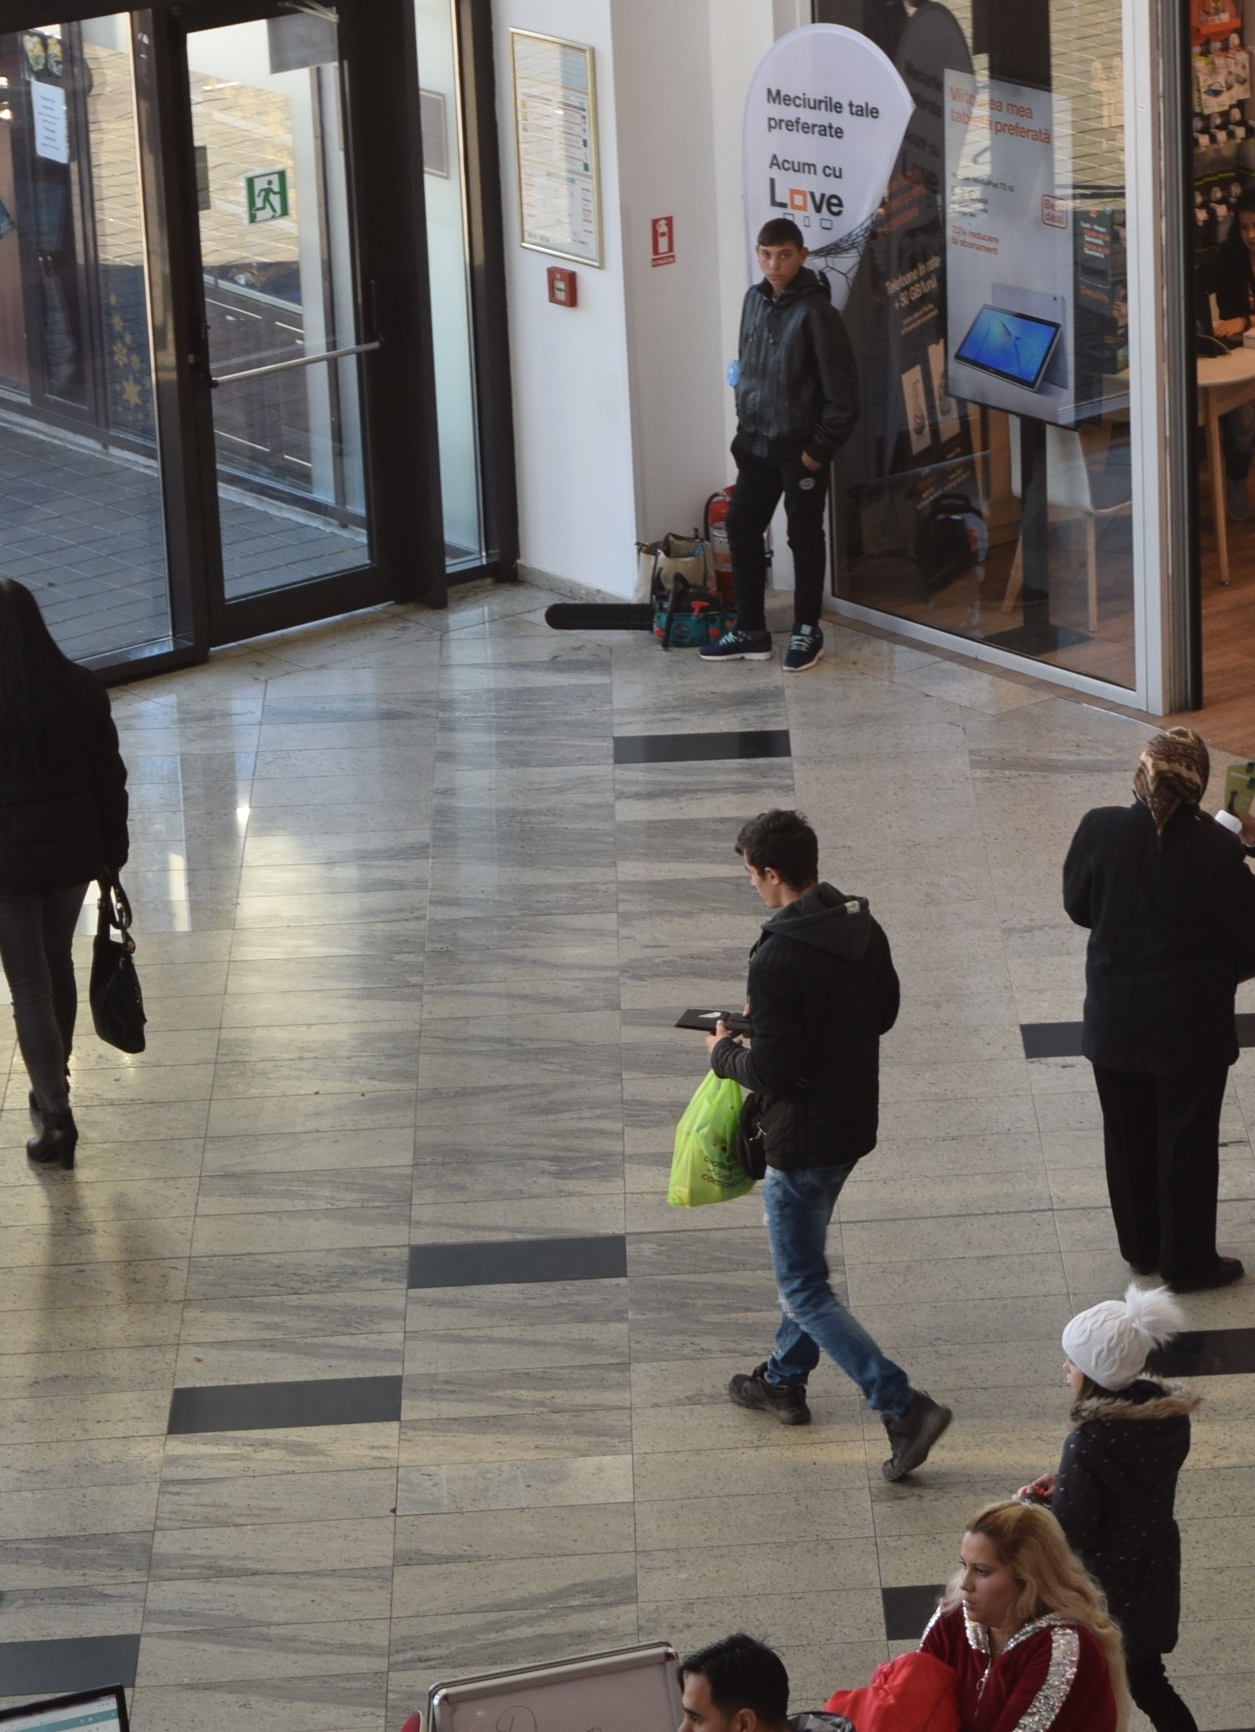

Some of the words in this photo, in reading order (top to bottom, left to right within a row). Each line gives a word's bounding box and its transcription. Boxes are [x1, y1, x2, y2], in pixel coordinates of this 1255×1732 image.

[766, 87, 844, 114] Meciurile
[847, 100, 880, 119] tale
[1006, 103, 1034, 120] mea
[767, 116, 844, 139] preferate
[994, 119, 1052, 144] preferată
[769, 153, 817, 176] Acum
[822, 164, 843, 179] cu
